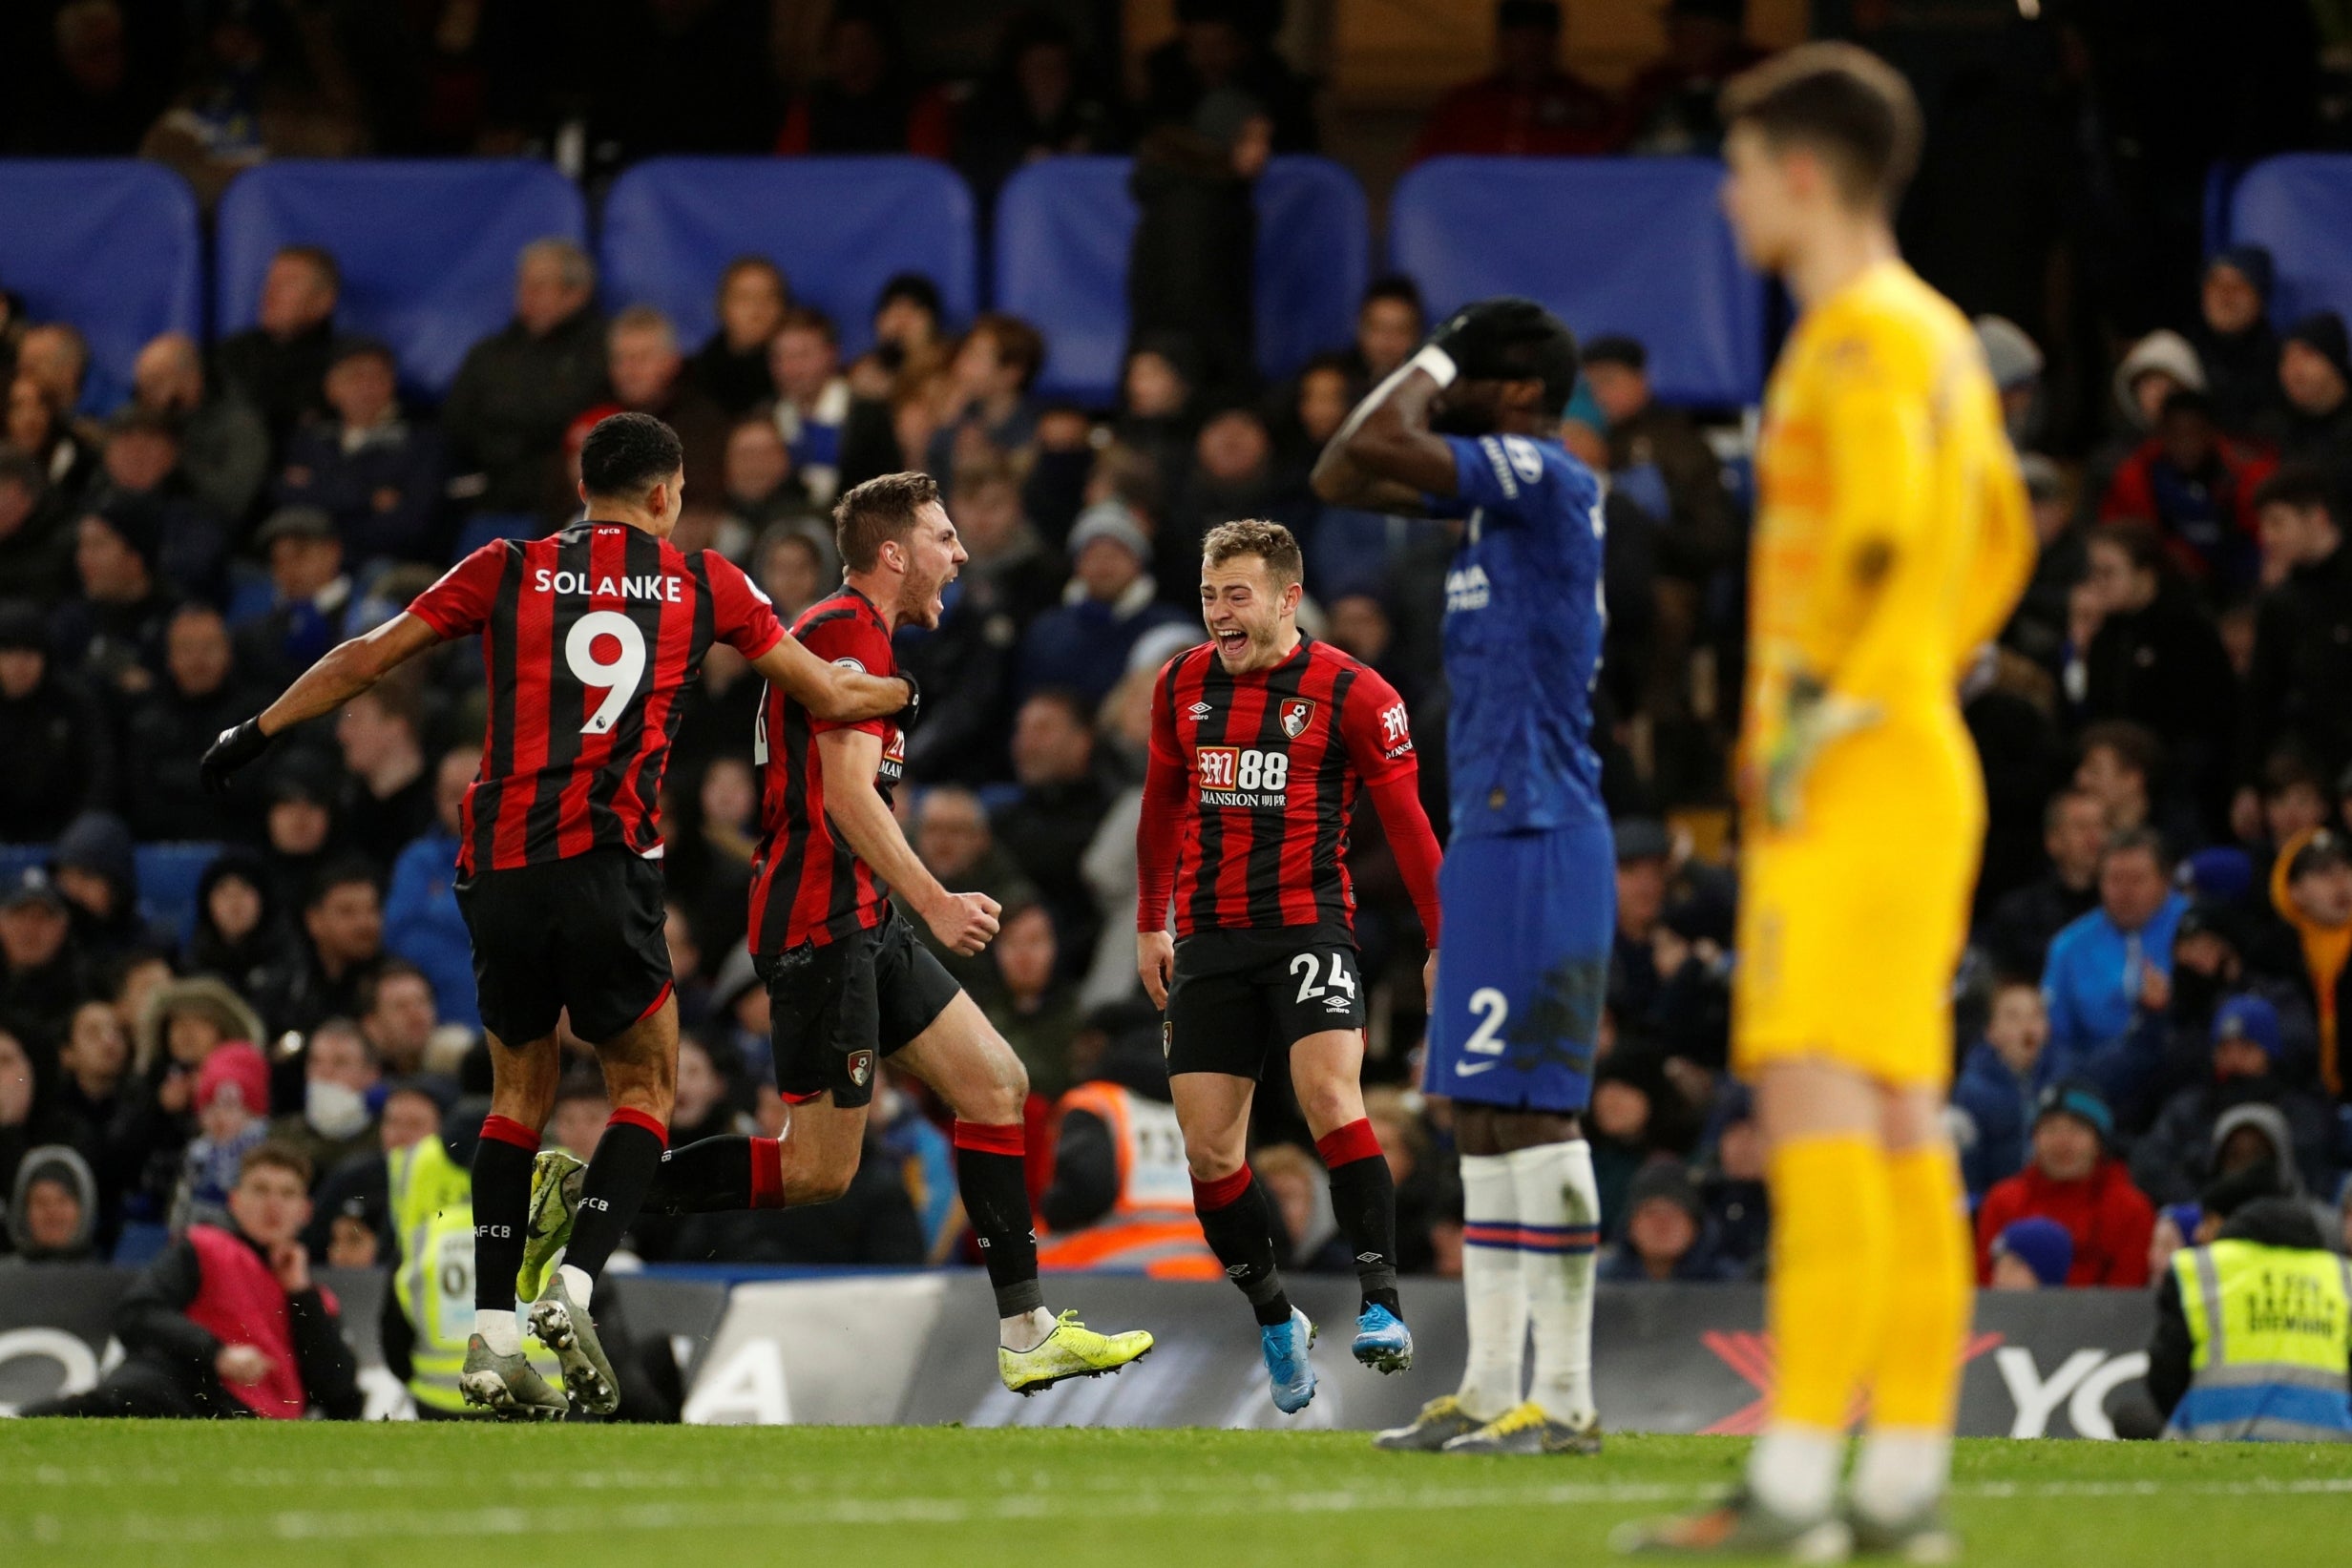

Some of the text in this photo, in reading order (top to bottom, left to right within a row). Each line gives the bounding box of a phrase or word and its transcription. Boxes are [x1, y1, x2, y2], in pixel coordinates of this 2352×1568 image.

[535, 569, 682, 603] SOLANKE
[565, 610, 646, 735] 9
[1201, 789, 1259, 807] MANSION
[1290, 952, 1355, 1004] 24
[1464, 987, 1508, 1056] 2
